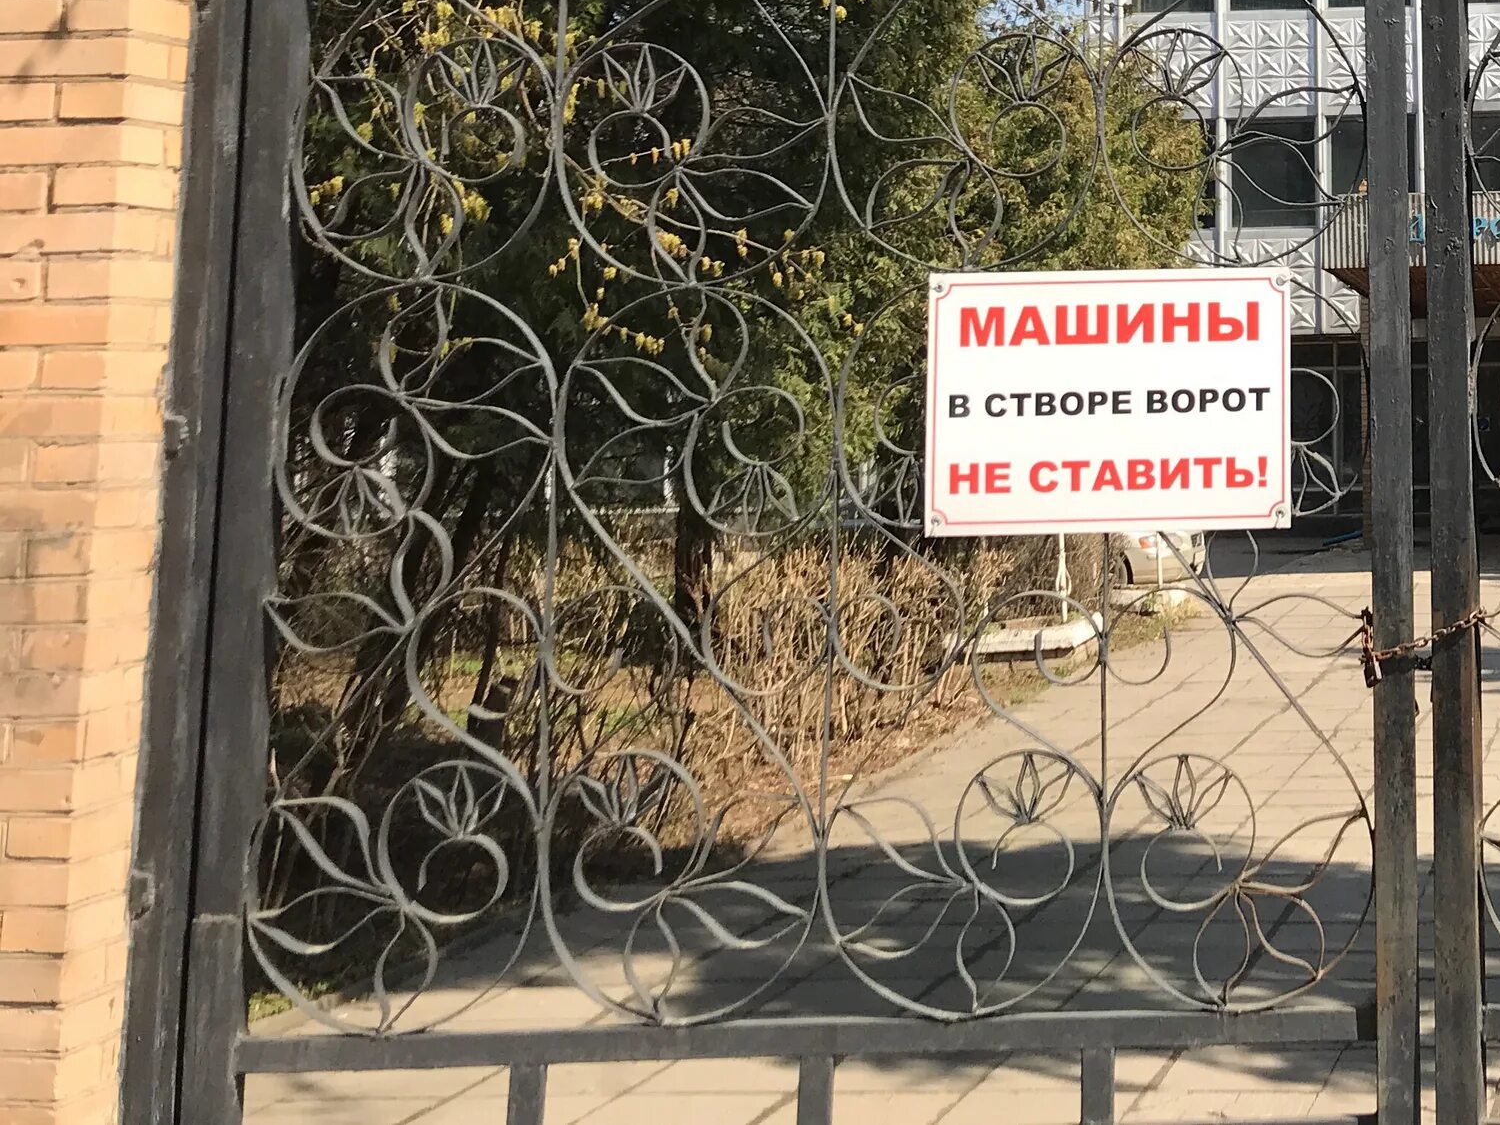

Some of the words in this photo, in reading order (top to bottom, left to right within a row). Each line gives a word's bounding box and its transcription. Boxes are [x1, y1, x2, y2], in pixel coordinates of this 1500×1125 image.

[960, 301, 1260, 347] МАШИНЫ
[948, 394, 971, 418] В
[984, 390, 1132, 418] СТВОРЕ
[1146, 387, 1271, 414] ВОРОТ
[949, 462, 1012, 494] НЕ
[1029, 456, 1268, 493] СТАВИТЬ!
